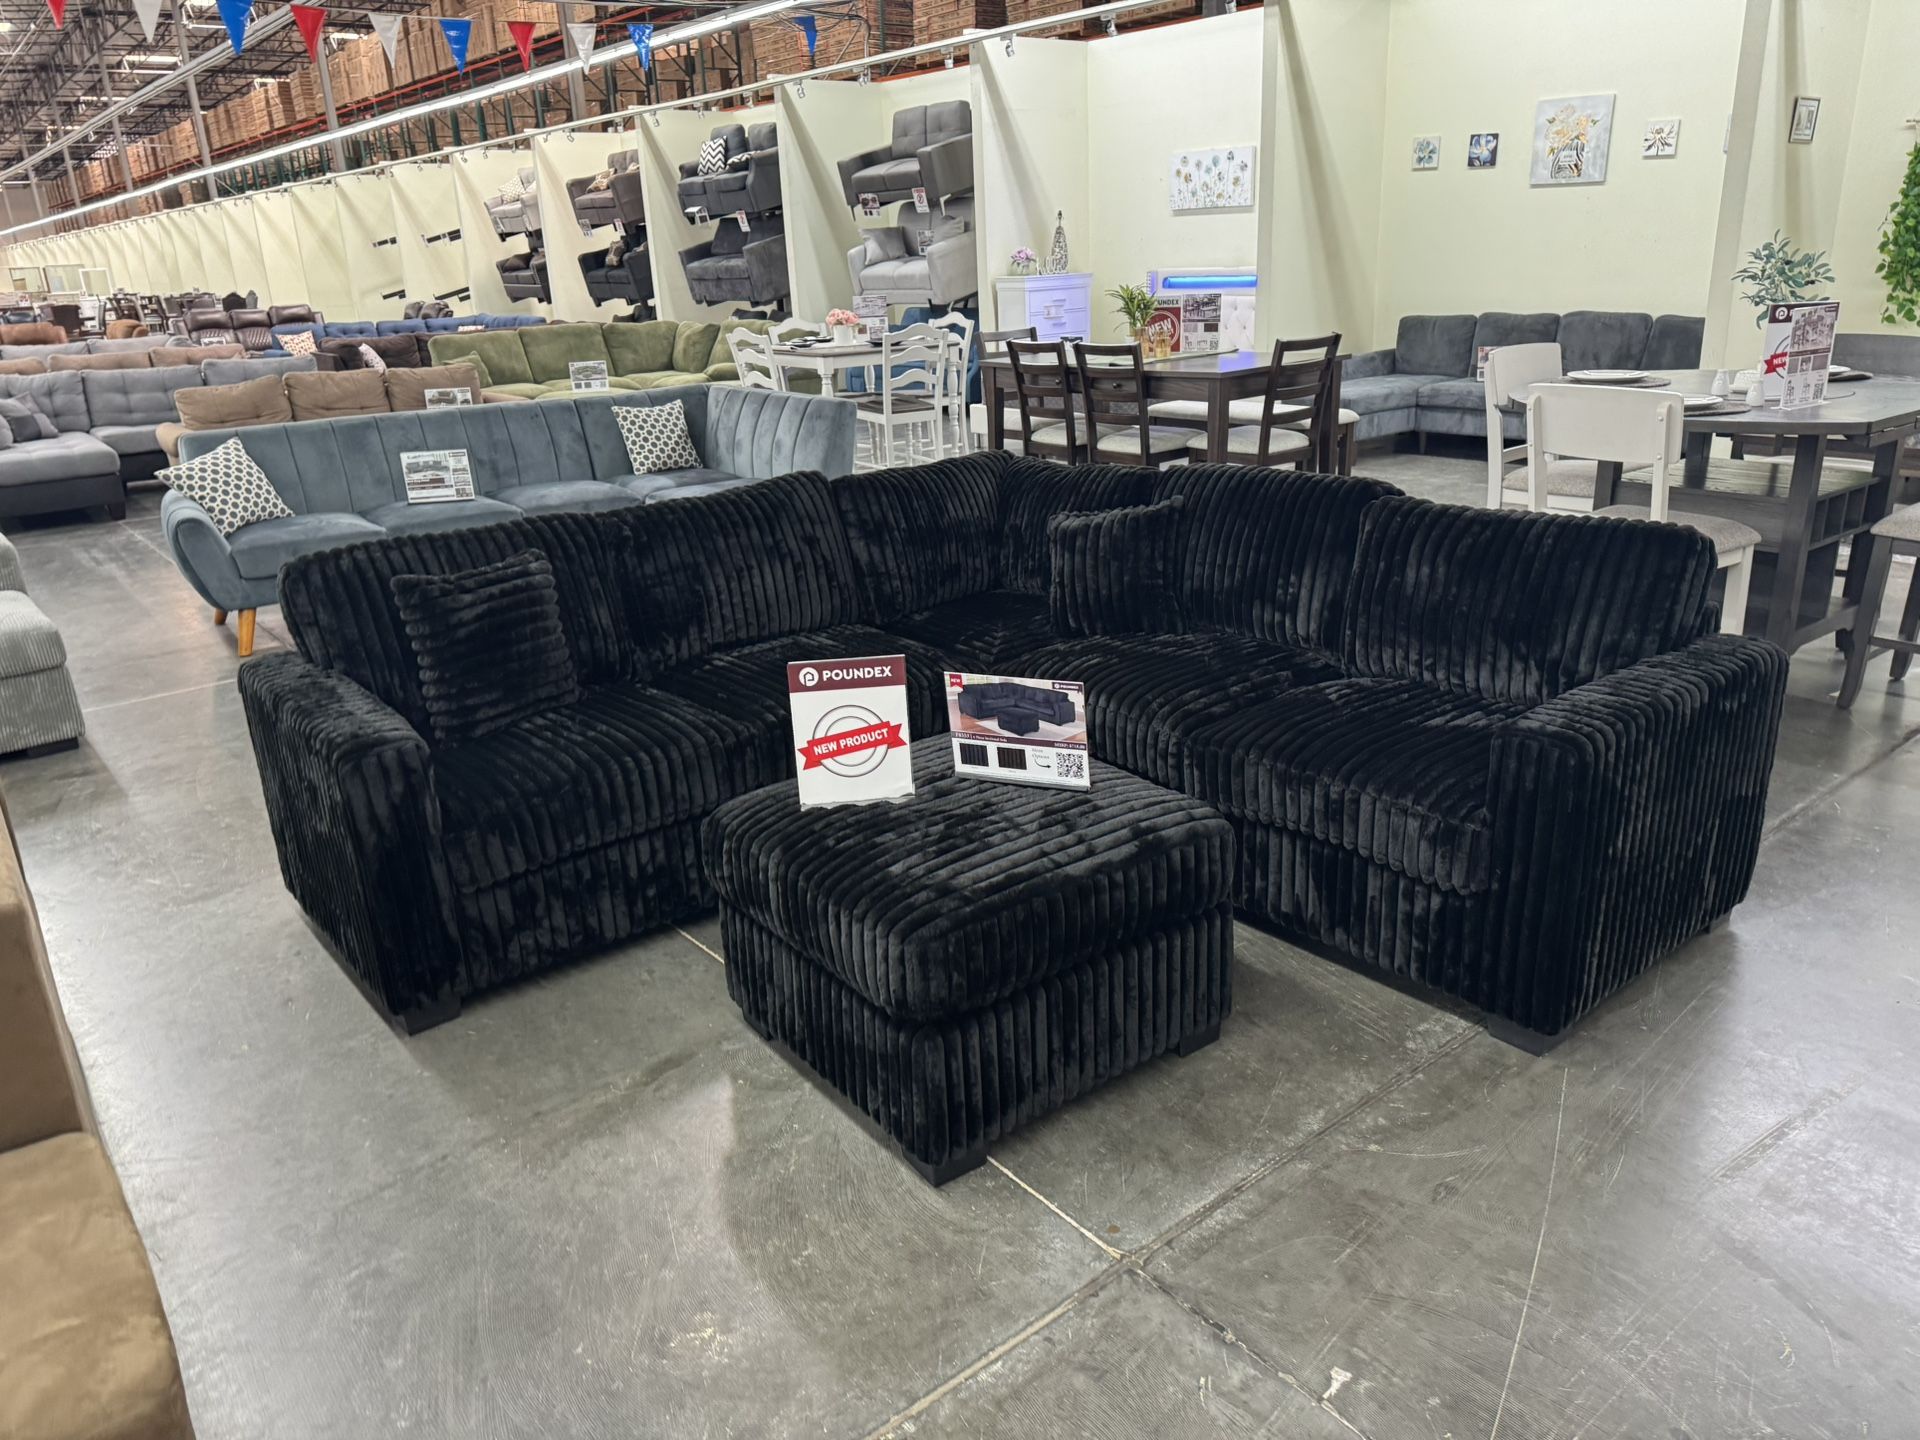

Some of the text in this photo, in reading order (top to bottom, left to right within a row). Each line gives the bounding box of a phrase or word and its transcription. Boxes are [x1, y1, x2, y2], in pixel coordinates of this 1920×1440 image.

[1148, 317, 1173, 340] NEW
[822, 665, 893, 682] POUNDEX
[813, 728, 889, 756] NEW PRODUCT
